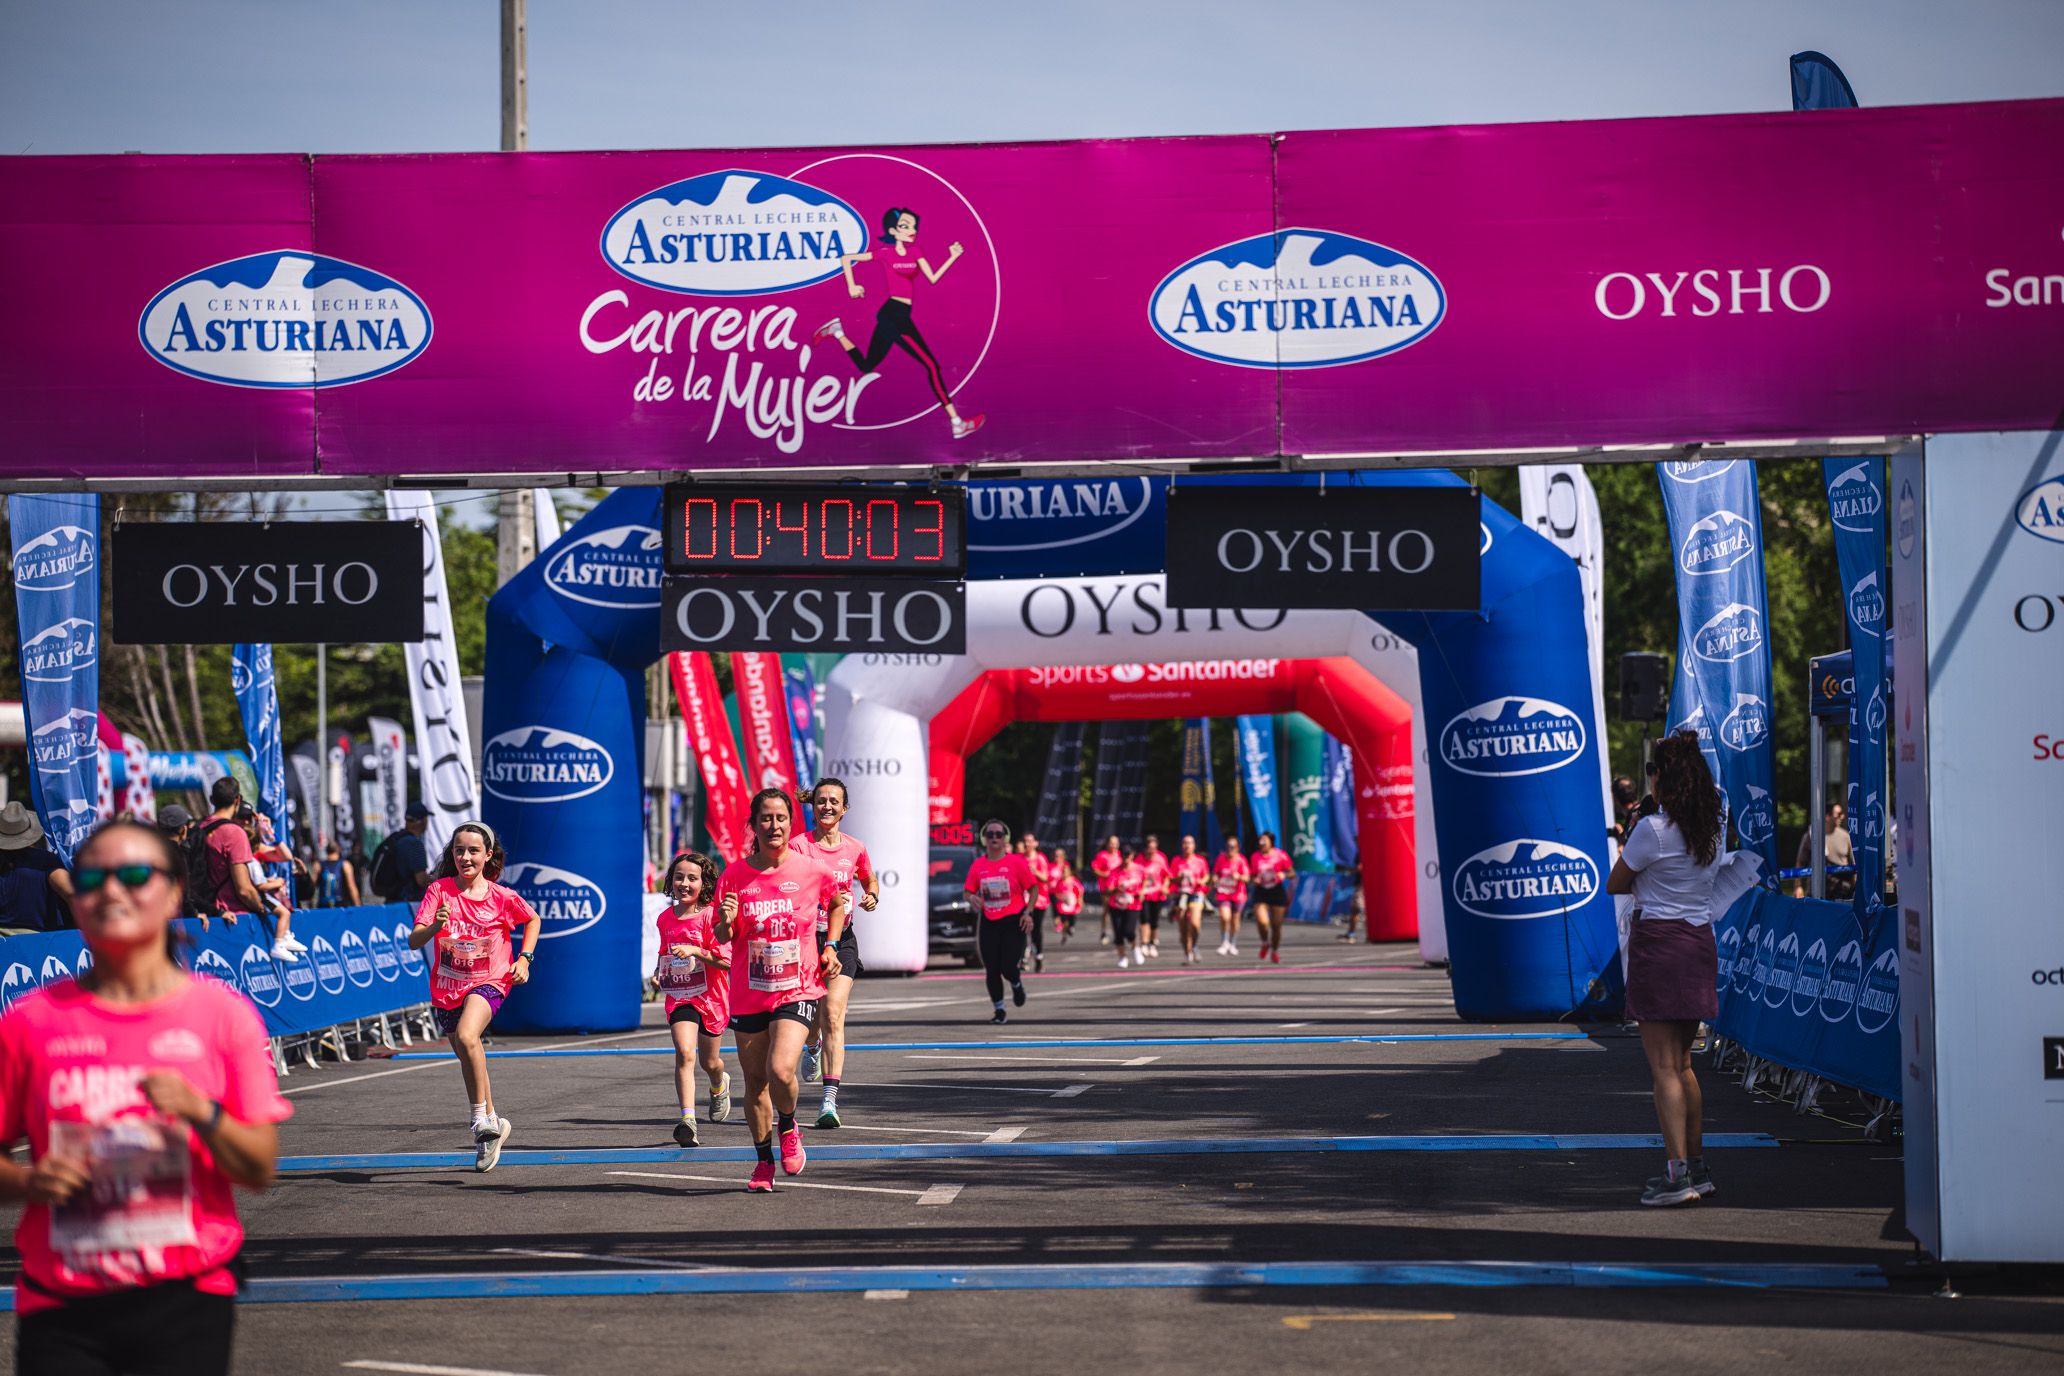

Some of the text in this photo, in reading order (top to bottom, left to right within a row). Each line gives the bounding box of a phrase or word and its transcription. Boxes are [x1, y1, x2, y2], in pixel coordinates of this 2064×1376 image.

[663, 211, 839, 227] CENTRAL LECHERA
[622, 218, 845, 265] ASTURIANA
[1217, 274, 1413, 292] CENTRAL LECHERA
[1594, 264, 1832, 320] OYSHO
[207, 298, 400, 312] CENTRAL LECHERA
[1173, 283, 1424, 333] ASTURIANA
[162, 301, 411, 353] ASTURIANA
[578, 290, 799, 354] Carrera
[634, 345, 882, 454] de la Mujer
[966, 483, 1131, 522] URIANA
[684, 498, 944, 561] 00:40:03
[584, 551, 639, 563] CENTRAL
[1216, 528, 1436, 575] OYSHO
[162, 561, 379, 608] OYSHO
[553, 553, 662, 588] ASTURI
[676, 587, 953, 646] OYSHO
[1466, 718, 1574, 736] CENTRAL LECHERA
[546, 752, 599, 760] LECHERA
[1449, 730, 1580, 760] ASTURIANA
[485, 752, 602, 783] ASTURIANA
[829, 757, 902, 777] OYSHO
[1480, 862, 1587, 878] CENTRAL LECHERA
[537, 889, 591, 898] LECHERA
[1462, 872, 1593, 902] ASTURIANA
[742, 898, 794, 918] CARRERA
[763, 964, 784, 974] 016
